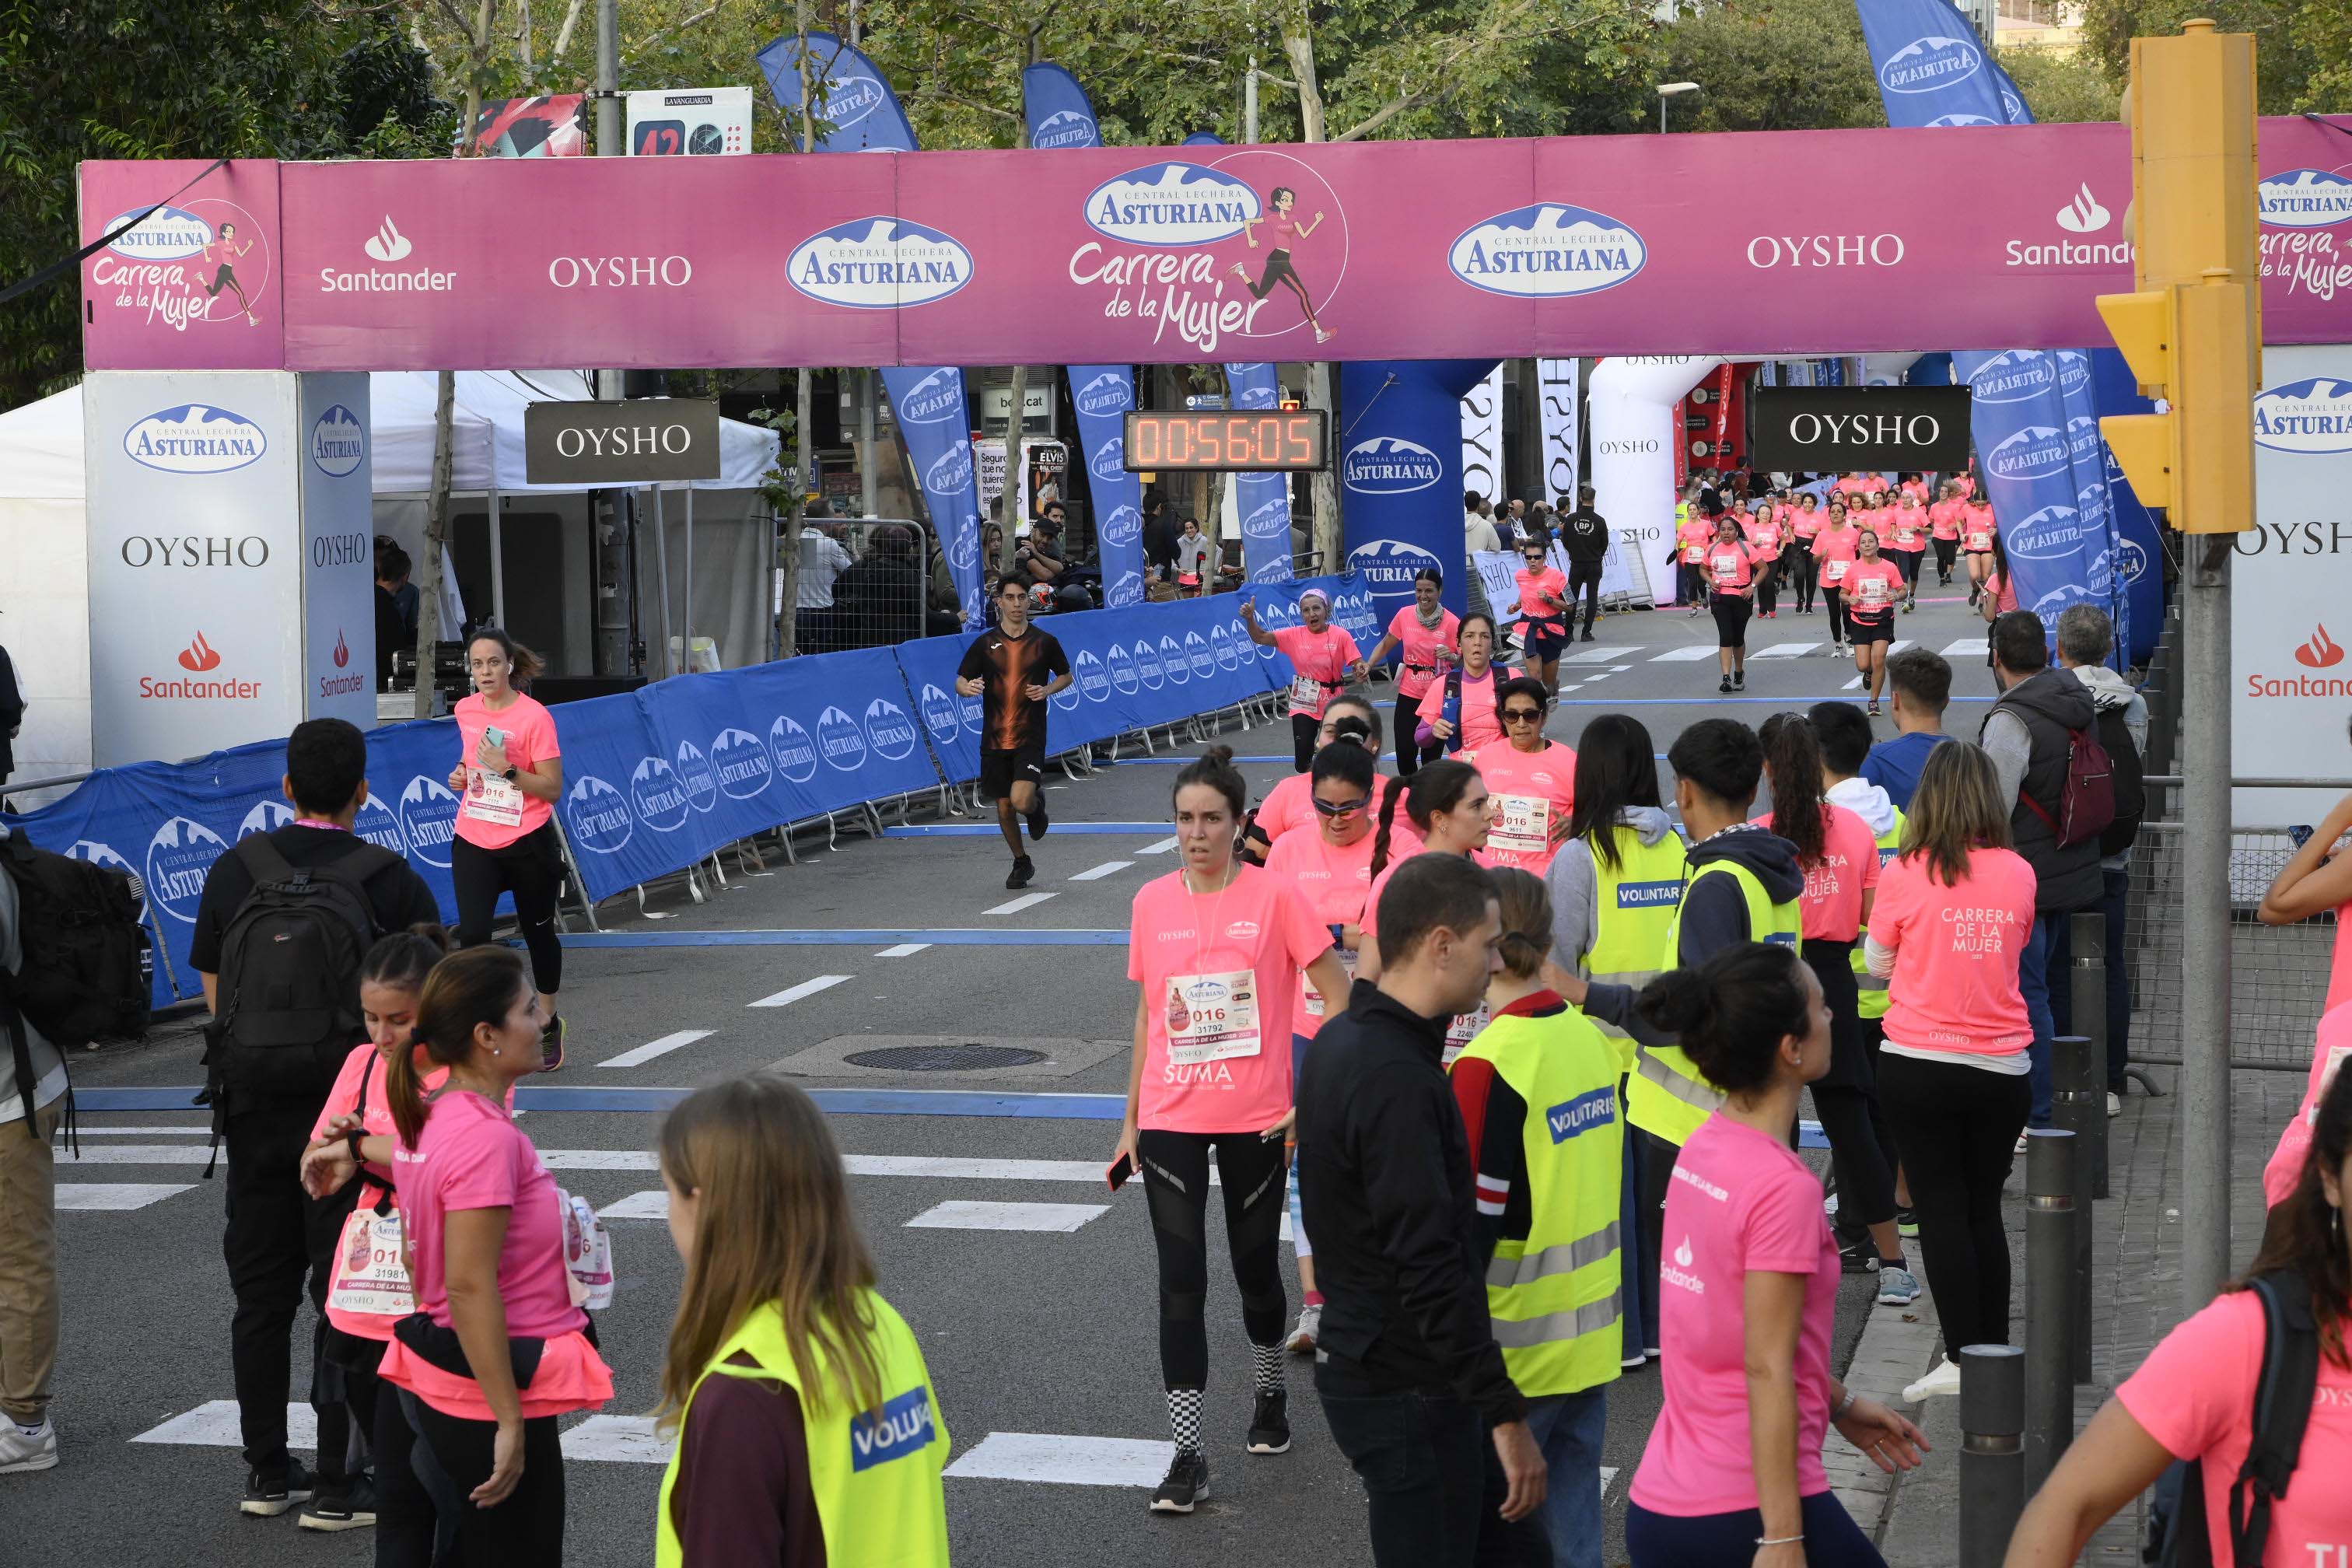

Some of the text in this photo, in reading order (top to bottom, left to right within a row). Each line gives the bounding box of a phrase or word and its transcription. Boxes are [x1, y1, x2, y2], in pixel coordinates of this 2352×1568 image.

[1125, 189, 1242, 200] CENTRAL LECHERA
[1097, 194, 1248, 226] ASTURIANA
[1494, 235, 1625, 247] CENTRAL LECHERA
[1747, 234, 1905, 268] OYSHO
[2259, 232, 2333, 254] arrera
[829, 247, 953, 257] CENTRAL LECHERA
[1464, 240, 1632, 275] ASTURIANA
[2006, 240, 2135, 266] Santand
[93, 257, 184, 285] Carrera
[549, 256, 692, 288] OYSHO
[800, 251, 960, 285] ASTURIANA
[1069, 242, 1214, 285] Carrera
[321, 267, 457, 292] Santander
[2277, 253, 2352, 302] la Muje
[116, 283, 219, 331] de la Mujer
[1105, 279, 1269, 352] de la Mujer
[1138, 419, 1310, 460] 00:56:05
[1790, 413, 1940, 445] OYSHO
[135, 430, 257, 457] ASTURIANA
[316, 433, 362, 460] ASTURIANA
[556, 425, 691, 457] OYSHO
[1600, 439, 1659, 455] OYSHO
[1040, 453, 1063, 462] ELVIS
[1346, 460, 1435, 481] ASTURIANA
[2233, 521, 2352, 555] OYSH
[121, 536, 269, 568] OYSHO
[314, 533, 366, 568] OYSHO
[320, 673, 364, 698] Santander
[1410, 672, 1436, 681] SUMA
[2249, 674, 2352, 698] Santan
[140, 677, 262, 698] Santander
[486, 788, 504, 798] 016
[412, 807, 435, 819] CENTRAL
[1506, 816, 1528, 826] 016
[165, 856, 195, 867] CENTRAL
[1820, 868, 1836, 883] LA
[1797, 881, 1839, 899] MUJER
[1941, 908, 2015, 925] CARRERA
[1158, 929, 1195, 941] OYSHO
[1955, 923, 2000, 938] DE LA
[1952, 937, 2003, 954] MUJER
[1189, 990, 1225, 999] ASTURIANA
[1193, 1008, 1226, 1022] 016
[1456, 1014, 1477, 1027] 016
[1197, 1024, 1223, 1034] 31792
[1929, 1031, 1970, 1045] OYSHO
[1164, 1062, 1233, 1083] SUMA
[1551, 1097, 1615, 1133] VOLUNTARIS
[374, 1249, 397, 1264] 01
[375, 1269, 405, 1279] 31981
